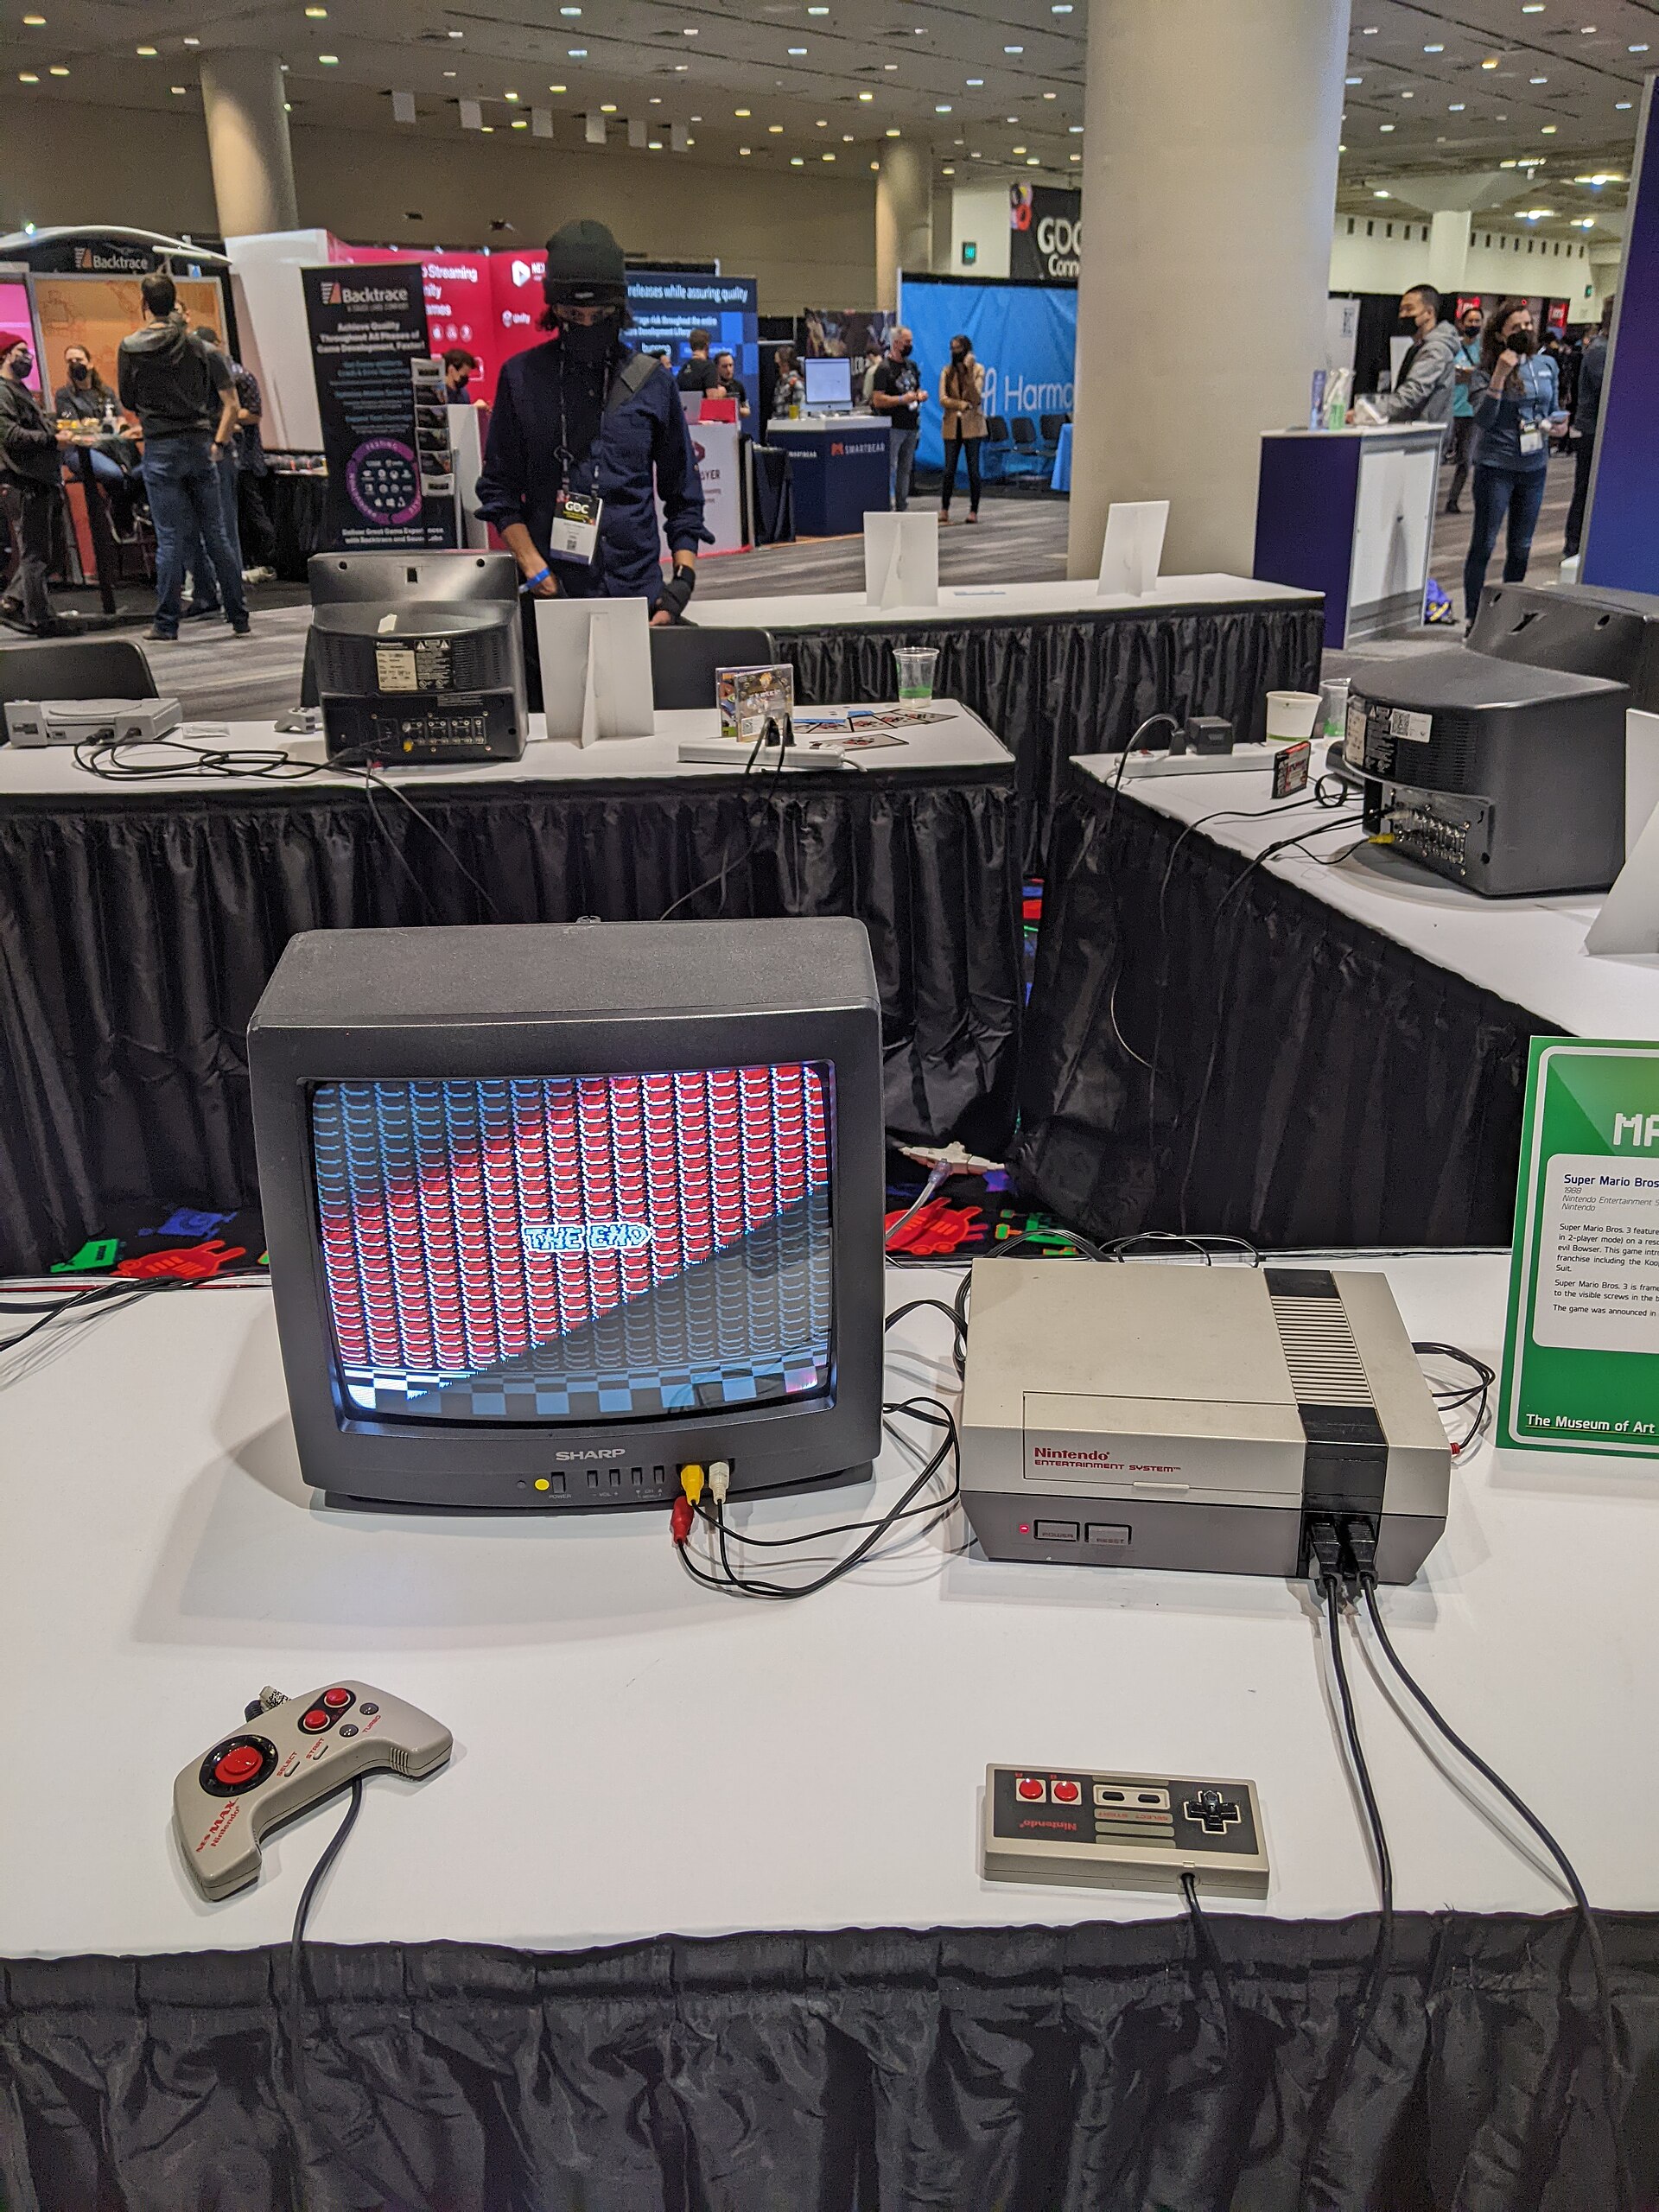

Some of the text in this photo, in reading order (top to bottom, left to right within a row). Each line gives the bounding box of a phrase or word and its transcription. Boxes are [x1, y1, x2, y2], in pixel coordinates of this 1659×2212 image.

[92, 254, 148, 270] Backtrace
[428, 264, 479, 283] Streaming
[341, 286, 408, 302] Backtrace
[664, 283, 686, 299] while
[721, 286, 748, 303] quality
[564, 501, 589, 514] GDC
[1564, 1174, 1659, 1188] Super Mario Bros
[1561, 1203, 1596, 1211] Nintendo
[1599, 1197, 1652, 1205] Entertainment
[1560, 1224, 1580, 1232] Super
[1583, 1224, 1604, 1233] Mario
[524, 1224, 649, 1250] THE END
[1573, 1244, 1602, 1253] Bowser.
[1557, 1254, 1590, 1262] franchise
[1593, 1255, 1624, 1266] including
[1554, 1279, 1576, 1287] Super
[1601, 1281, 1620, 1290] Bros.
[1568, 1306, 1589, 1314] game
[1608, 1308, 1647, 1317] announced
[1526, 1414, 1656, 1433] The Museum of Art
[556, 1448, 626, 1460] SHARP
[1034, 1459, 1125, 1470] ENTERTAINMENT
[362, 1714, 381, 1733] TURBO
[305, 1737, 325, 1759] START
[276, 1751, 297, 1777] SELECT
[195, 1797, 239, 1853] NES MAX
